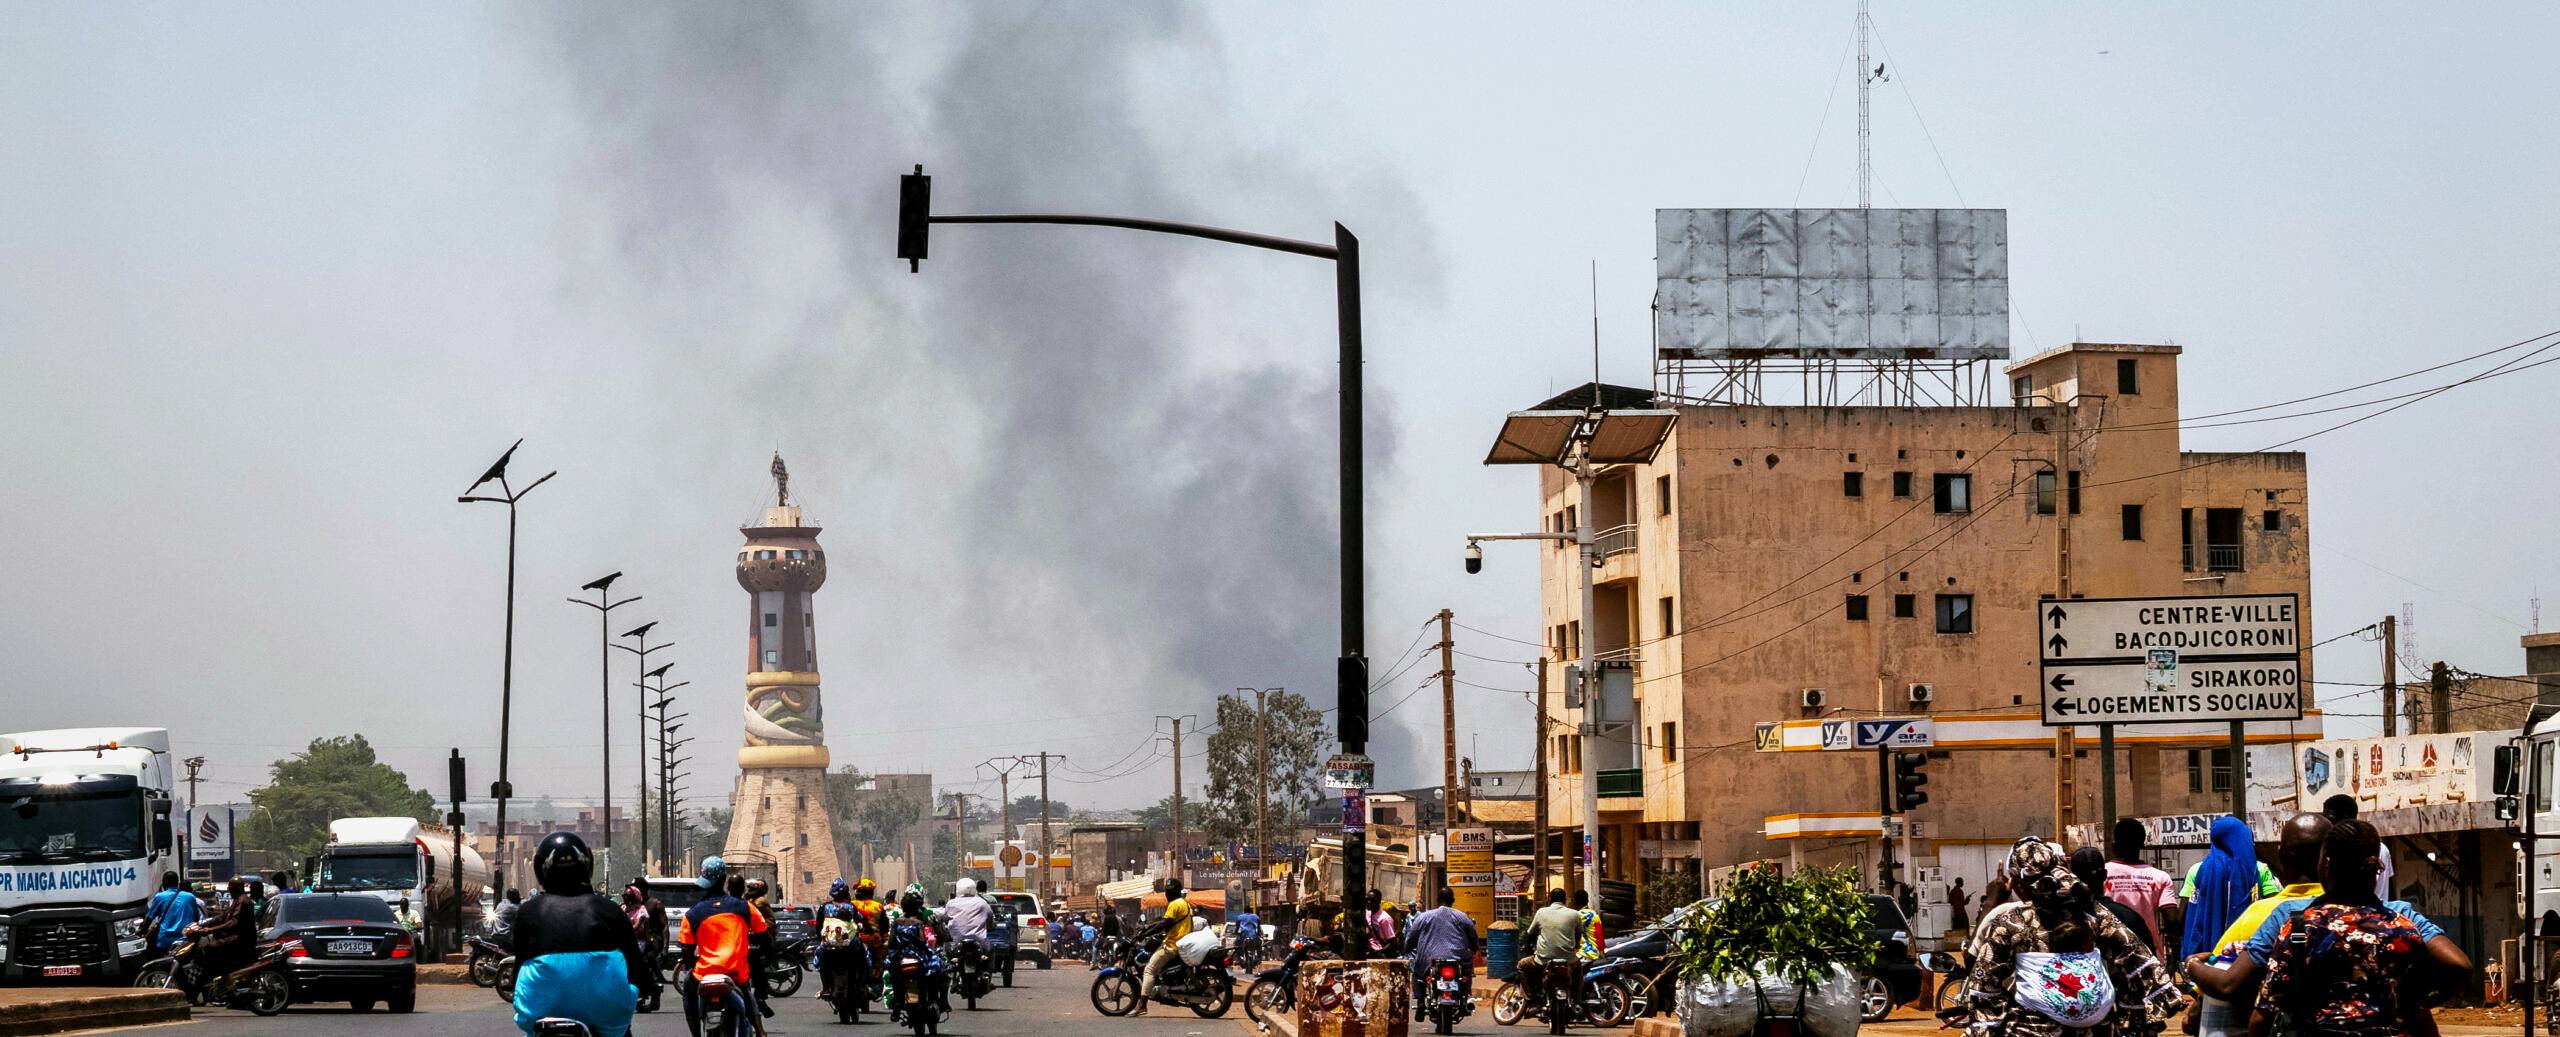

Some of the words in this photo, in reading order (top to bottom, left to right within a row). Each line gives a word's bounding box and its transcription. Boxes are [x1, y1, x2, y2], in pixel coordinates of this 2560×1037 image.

[2139, 605, 2292, 625] CENTRE-VILLE
[2115, 629, 2293, 650] BACODJICORONI
[2191, 668, 2296, 688] SIRAKORO
[2076, 695, 2201, 715] LOGEMENTS
[2206, 692, 2297, 711] SOCIAUX
[1463, 833, 1486, 842] BMS
[2162, 835, 2184, 846] AUTO
[2190, 833, 2211, 844] PAR
[16, 872, 57, 891] MAIGA
[60, 867, 122, 890] AICHATOU
[123, 867, 136, 881] 4
[1199, 870, 1208, 878] Le
